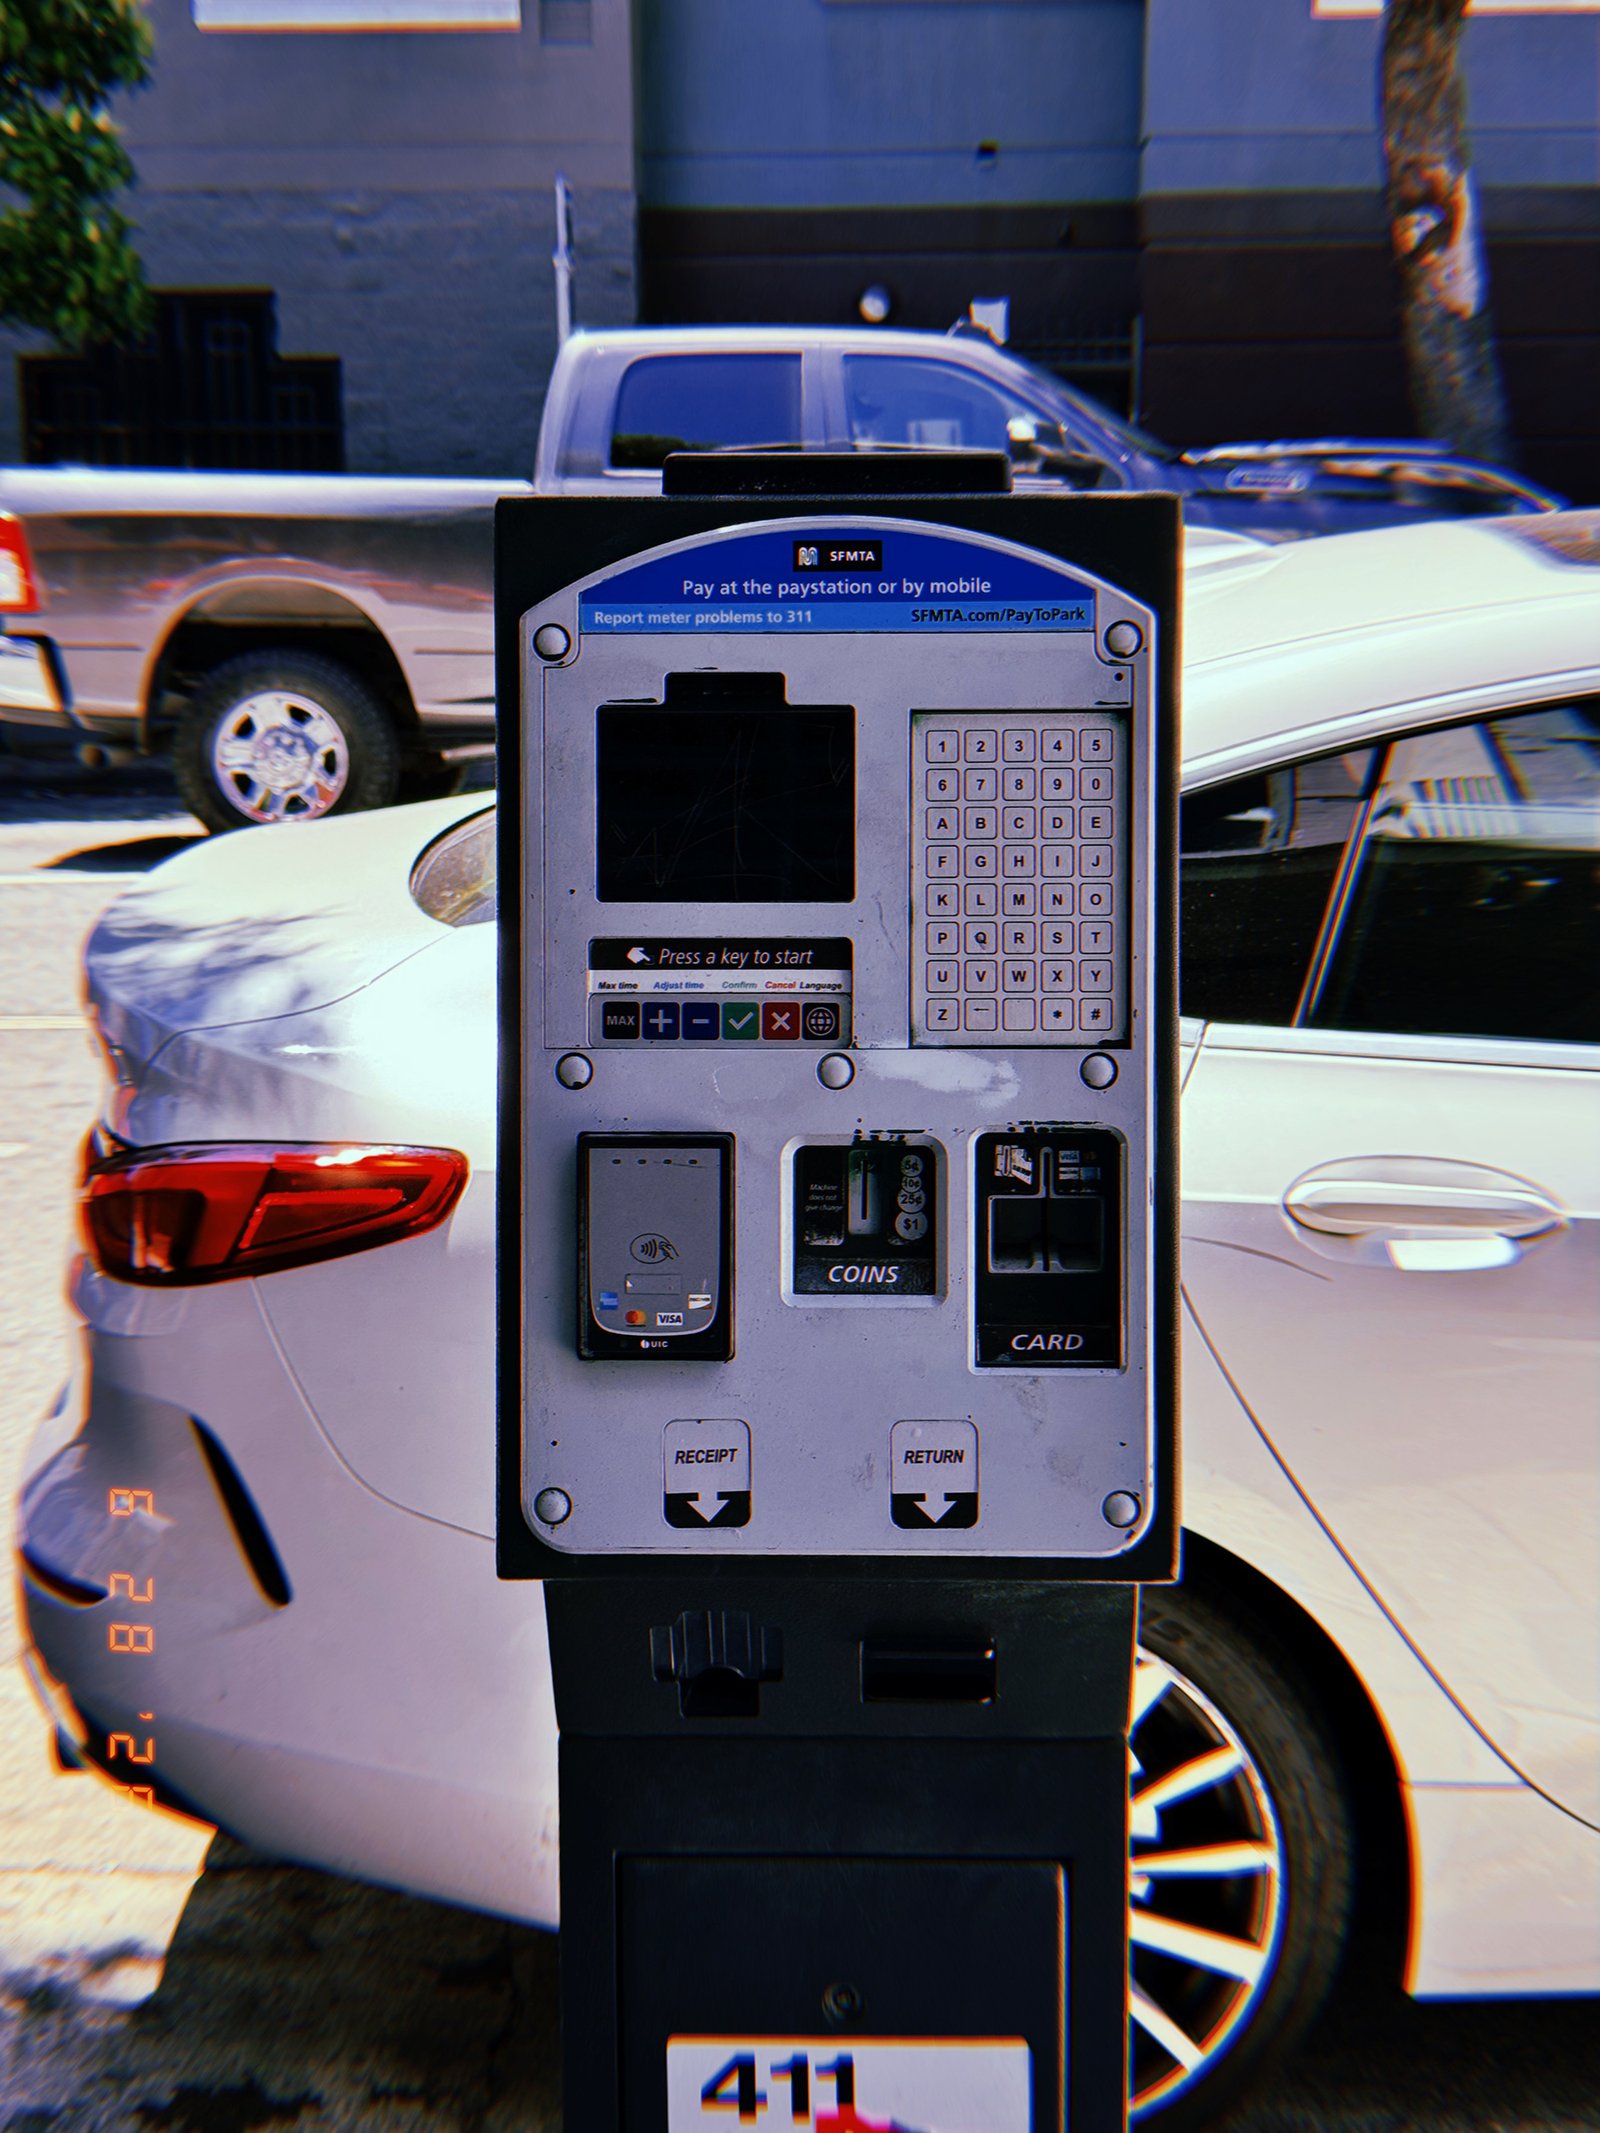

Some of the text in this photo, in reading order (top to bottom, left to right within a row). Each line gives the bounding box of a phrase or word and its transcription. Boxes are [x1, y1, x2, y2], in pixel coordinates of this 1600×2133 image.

[829, 550, 876, 562] SFMTA
[683, 577, 992, 600] Pay at the paystation or by mobile
[593, 608, 813, 627] Report meter problems to 311
[911, 607, 1086, 625] SFMTA.com/PayToPark
[938, 739, 1101, 753] 1 2 3 4 5
[938, 777, 1101, 792] 6 7 8 9 0
[936, 816, 1101, 830] A B C D E
[938, 855, 947, 868] F
[974, 855, 987, 868] G
[1013, 855, 1025, 868] H
[1091, 855, 1100, 867] J
[937, 893, 1102, 907] K L M N O
[937, 931, 1101, 946] P Q R S T
[658, 948, 814, 968] Press a key to start
[937, 970, 1101, 983] U V W X Y
[597, 981, 639, 990] Max time
[653, 981, 705, 992] Adjust time
[721, 981, 758, 990] Confirm
[764, 980, 796, 990] Cancel
[799, 981, 843, 993] Language
[606, 1014, 636, 1027] MAX
[937, 1008, 948, 1021] Z
[1090, 1008, 1101, 1021] #
[810, 1183, 838, 1191] Machine
[903, 1217, 919, 1231] $1
[828, 1265, 899, 1284] COINS
[658, 1314, 682, 1324] VISA
[650, 1340, 669, 1348] UIC
[1010, 1333, 1084, 1351] CARD
[674, 1448, 738, 1464] RECEIPT
[903, 1449, 965, 1464] RETURN
[701, 2051, 856, 2126] 411
